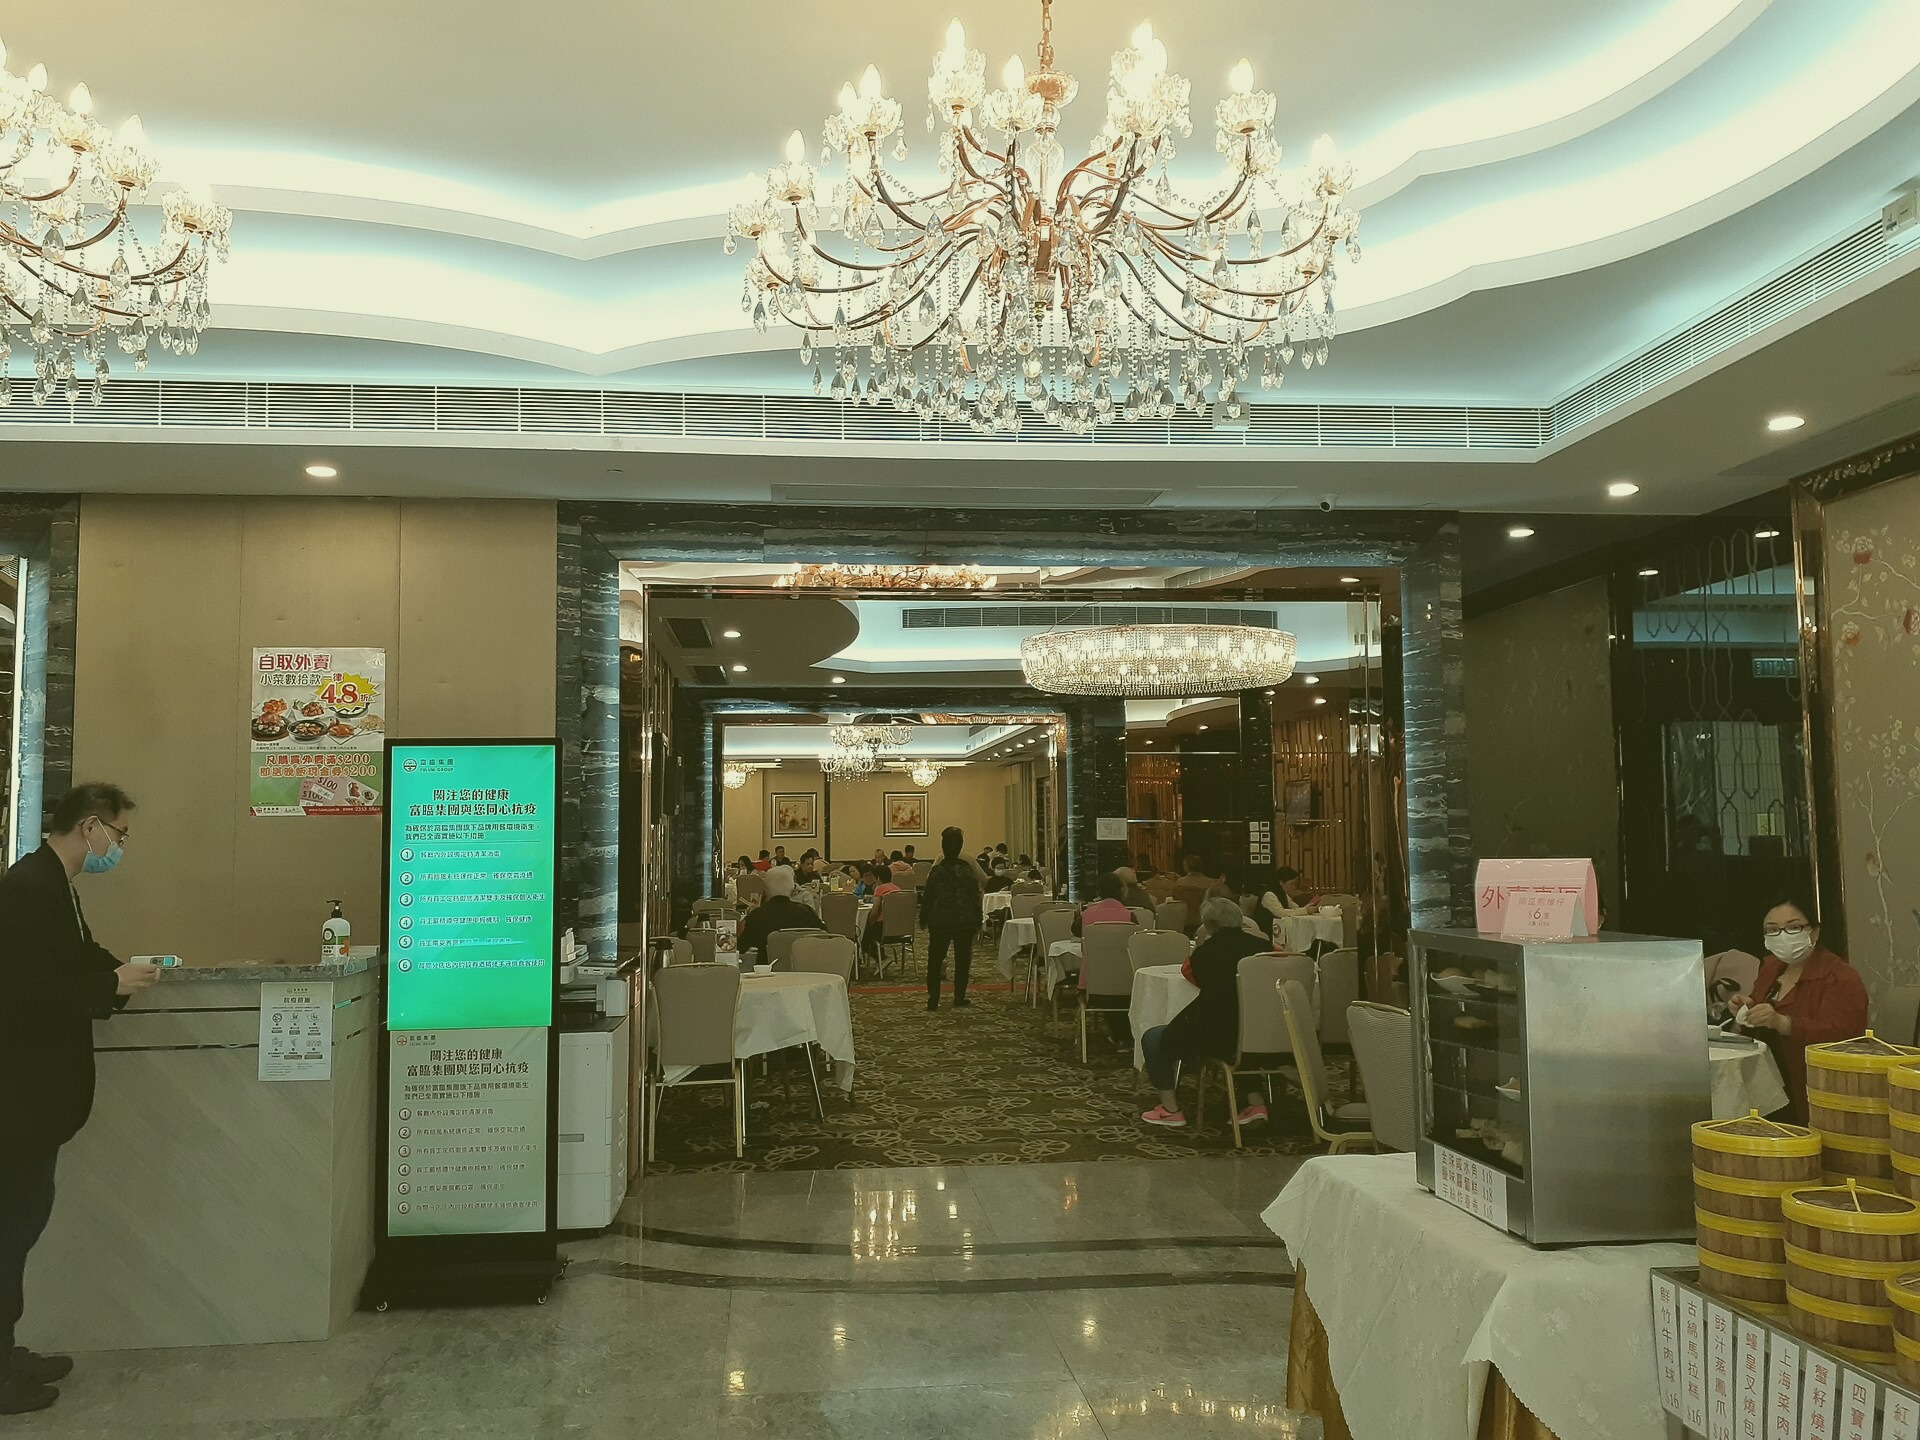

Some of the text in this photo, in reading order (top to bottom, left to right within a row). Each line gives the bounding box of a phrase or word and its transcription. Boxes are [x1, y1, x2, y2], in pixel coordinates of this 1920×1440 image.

[259, 654, 330, 670] 自取外賣
[260, 674, 321, 686] 小菜數拾款
[321, 684, 358, 704] 4.8
[433, 789, 509, 801] 關注您的健康
[409, 804, 537, 816] 富臨集團與您同心抗疫
[430, 1048, 503, 1062] 關注您的健康
[407, 1062, 529, 1077] 富臨集團與您同心抗疫
[1659, 1286, 1676, 1383] 鮮竹牛肉球
[1809, 1364, 1829, 1440] 蟹籽燒
